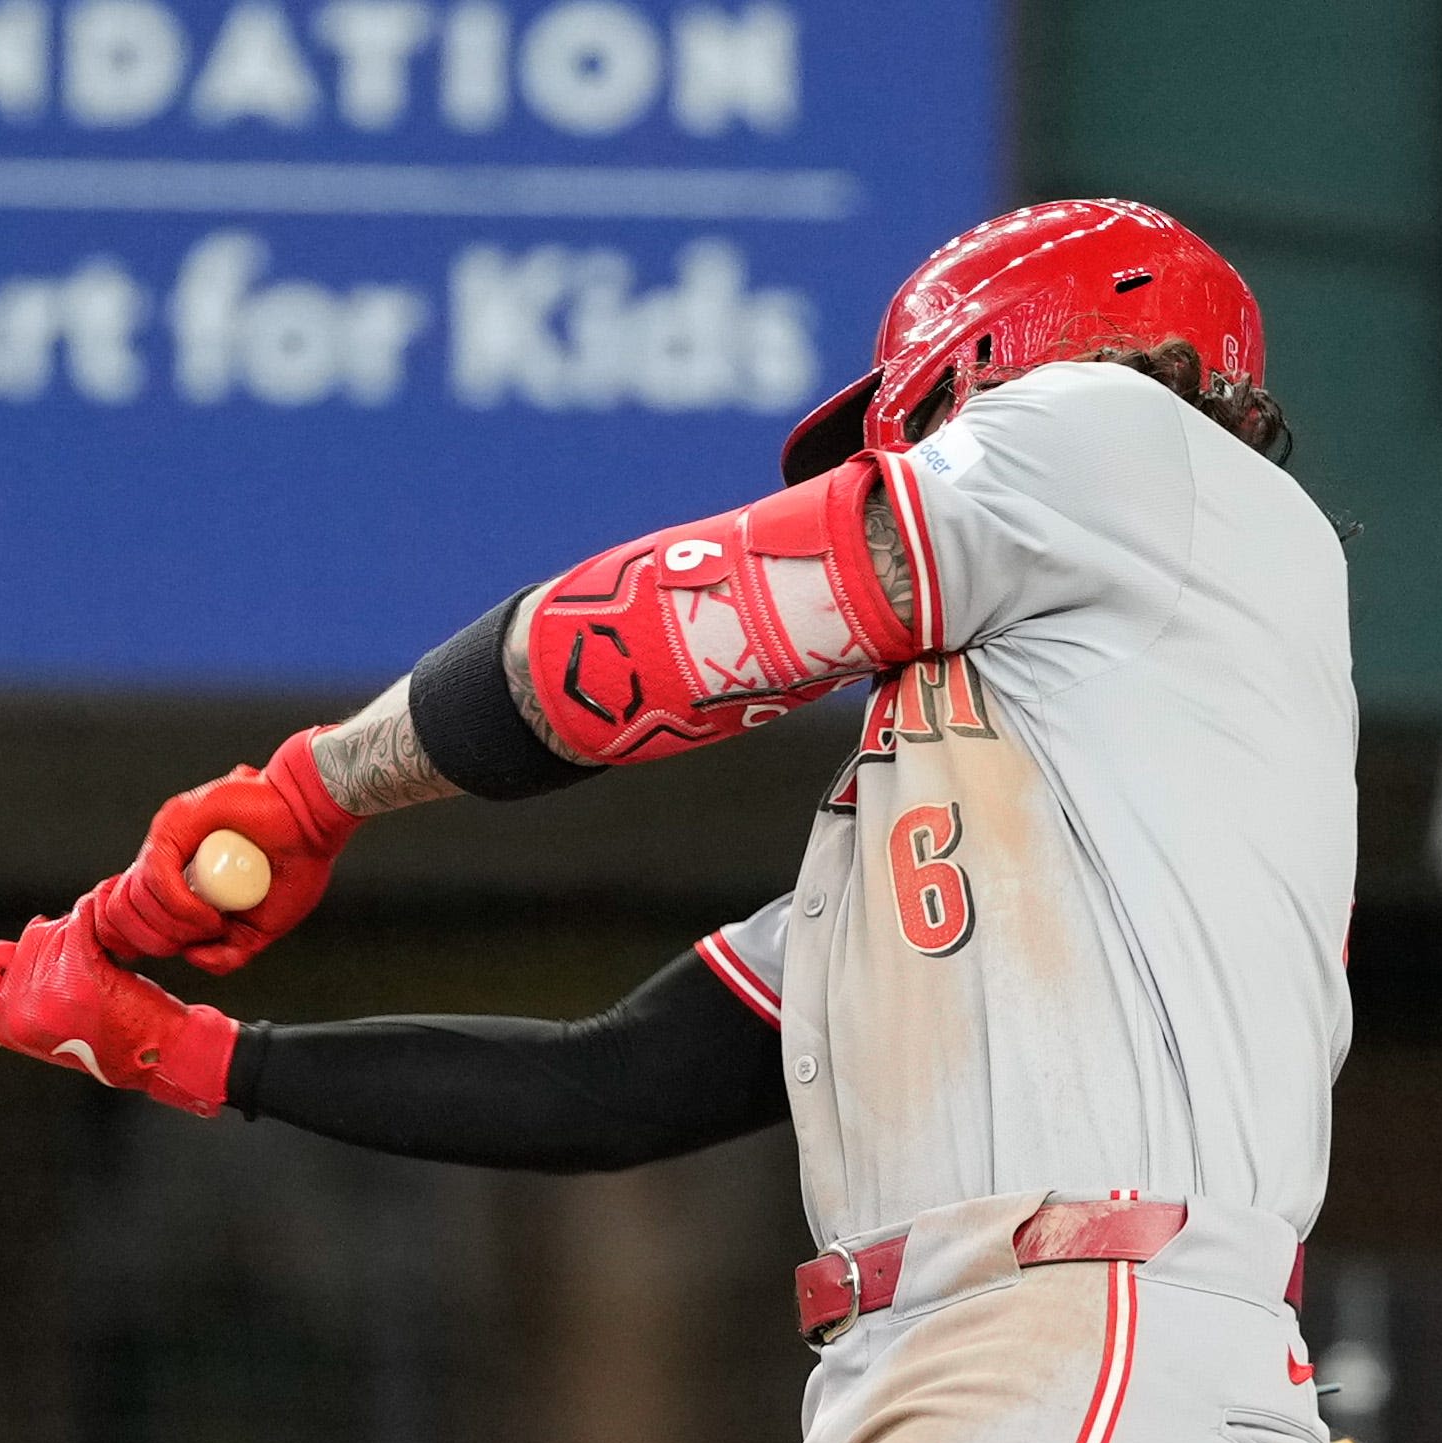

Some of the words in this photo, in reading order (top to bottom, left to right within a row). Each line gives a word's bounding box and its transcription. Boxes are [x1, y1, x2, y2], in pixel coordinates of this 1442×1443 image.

[169, 228, 423, 406] for
[449, 238, 817, 412] Kids
[887, 801, 976, 958] 6
